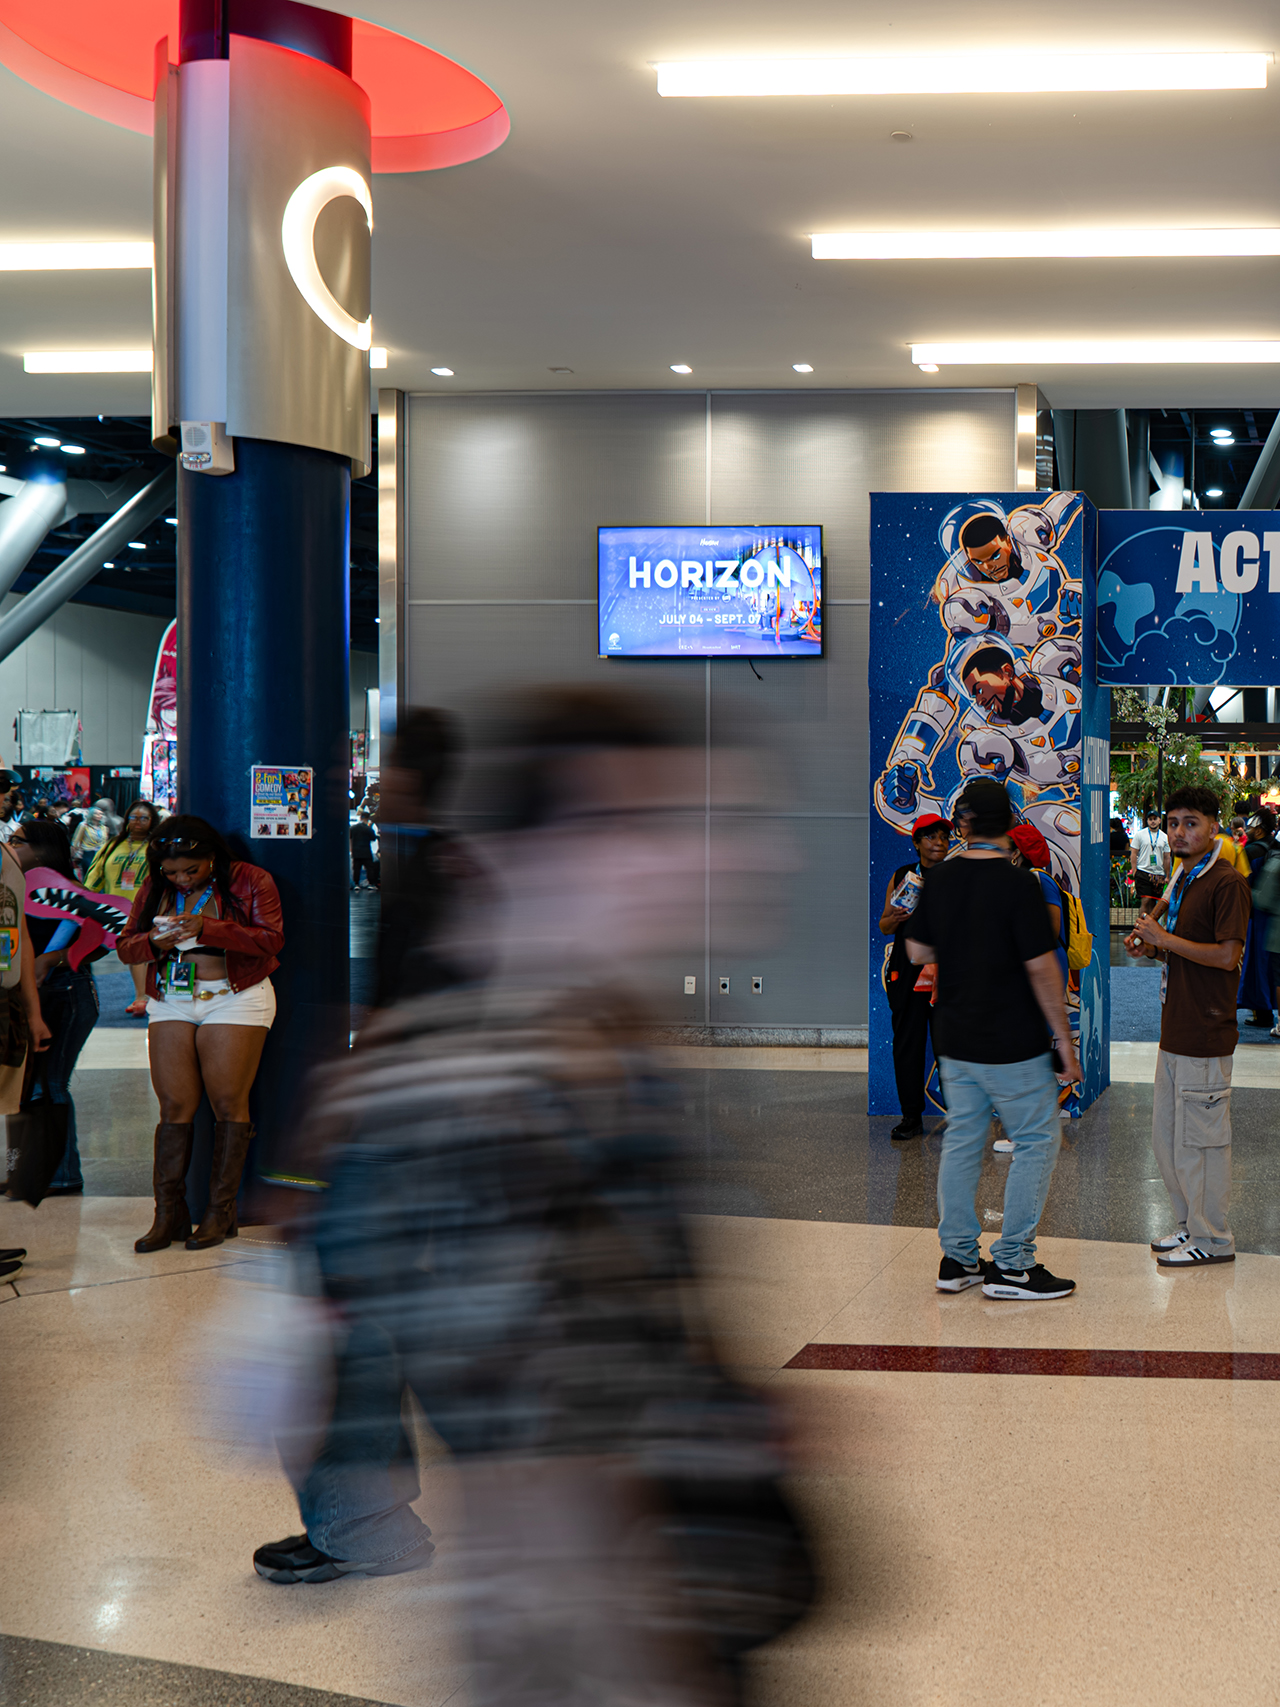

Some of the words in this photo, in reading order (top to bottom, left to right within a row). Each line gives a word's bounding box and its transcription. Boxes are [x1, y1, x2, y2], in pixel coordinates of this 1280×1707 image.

[629, 556, 791, 588] HORIZON
[659, 614, 687, 624] JULY
[689, 614, 704, 624] 04
[714, 614, 746, 625] SEPT.
[748, 614, 762, 624] 07
[255, 783, 282, 793] COMEDY
